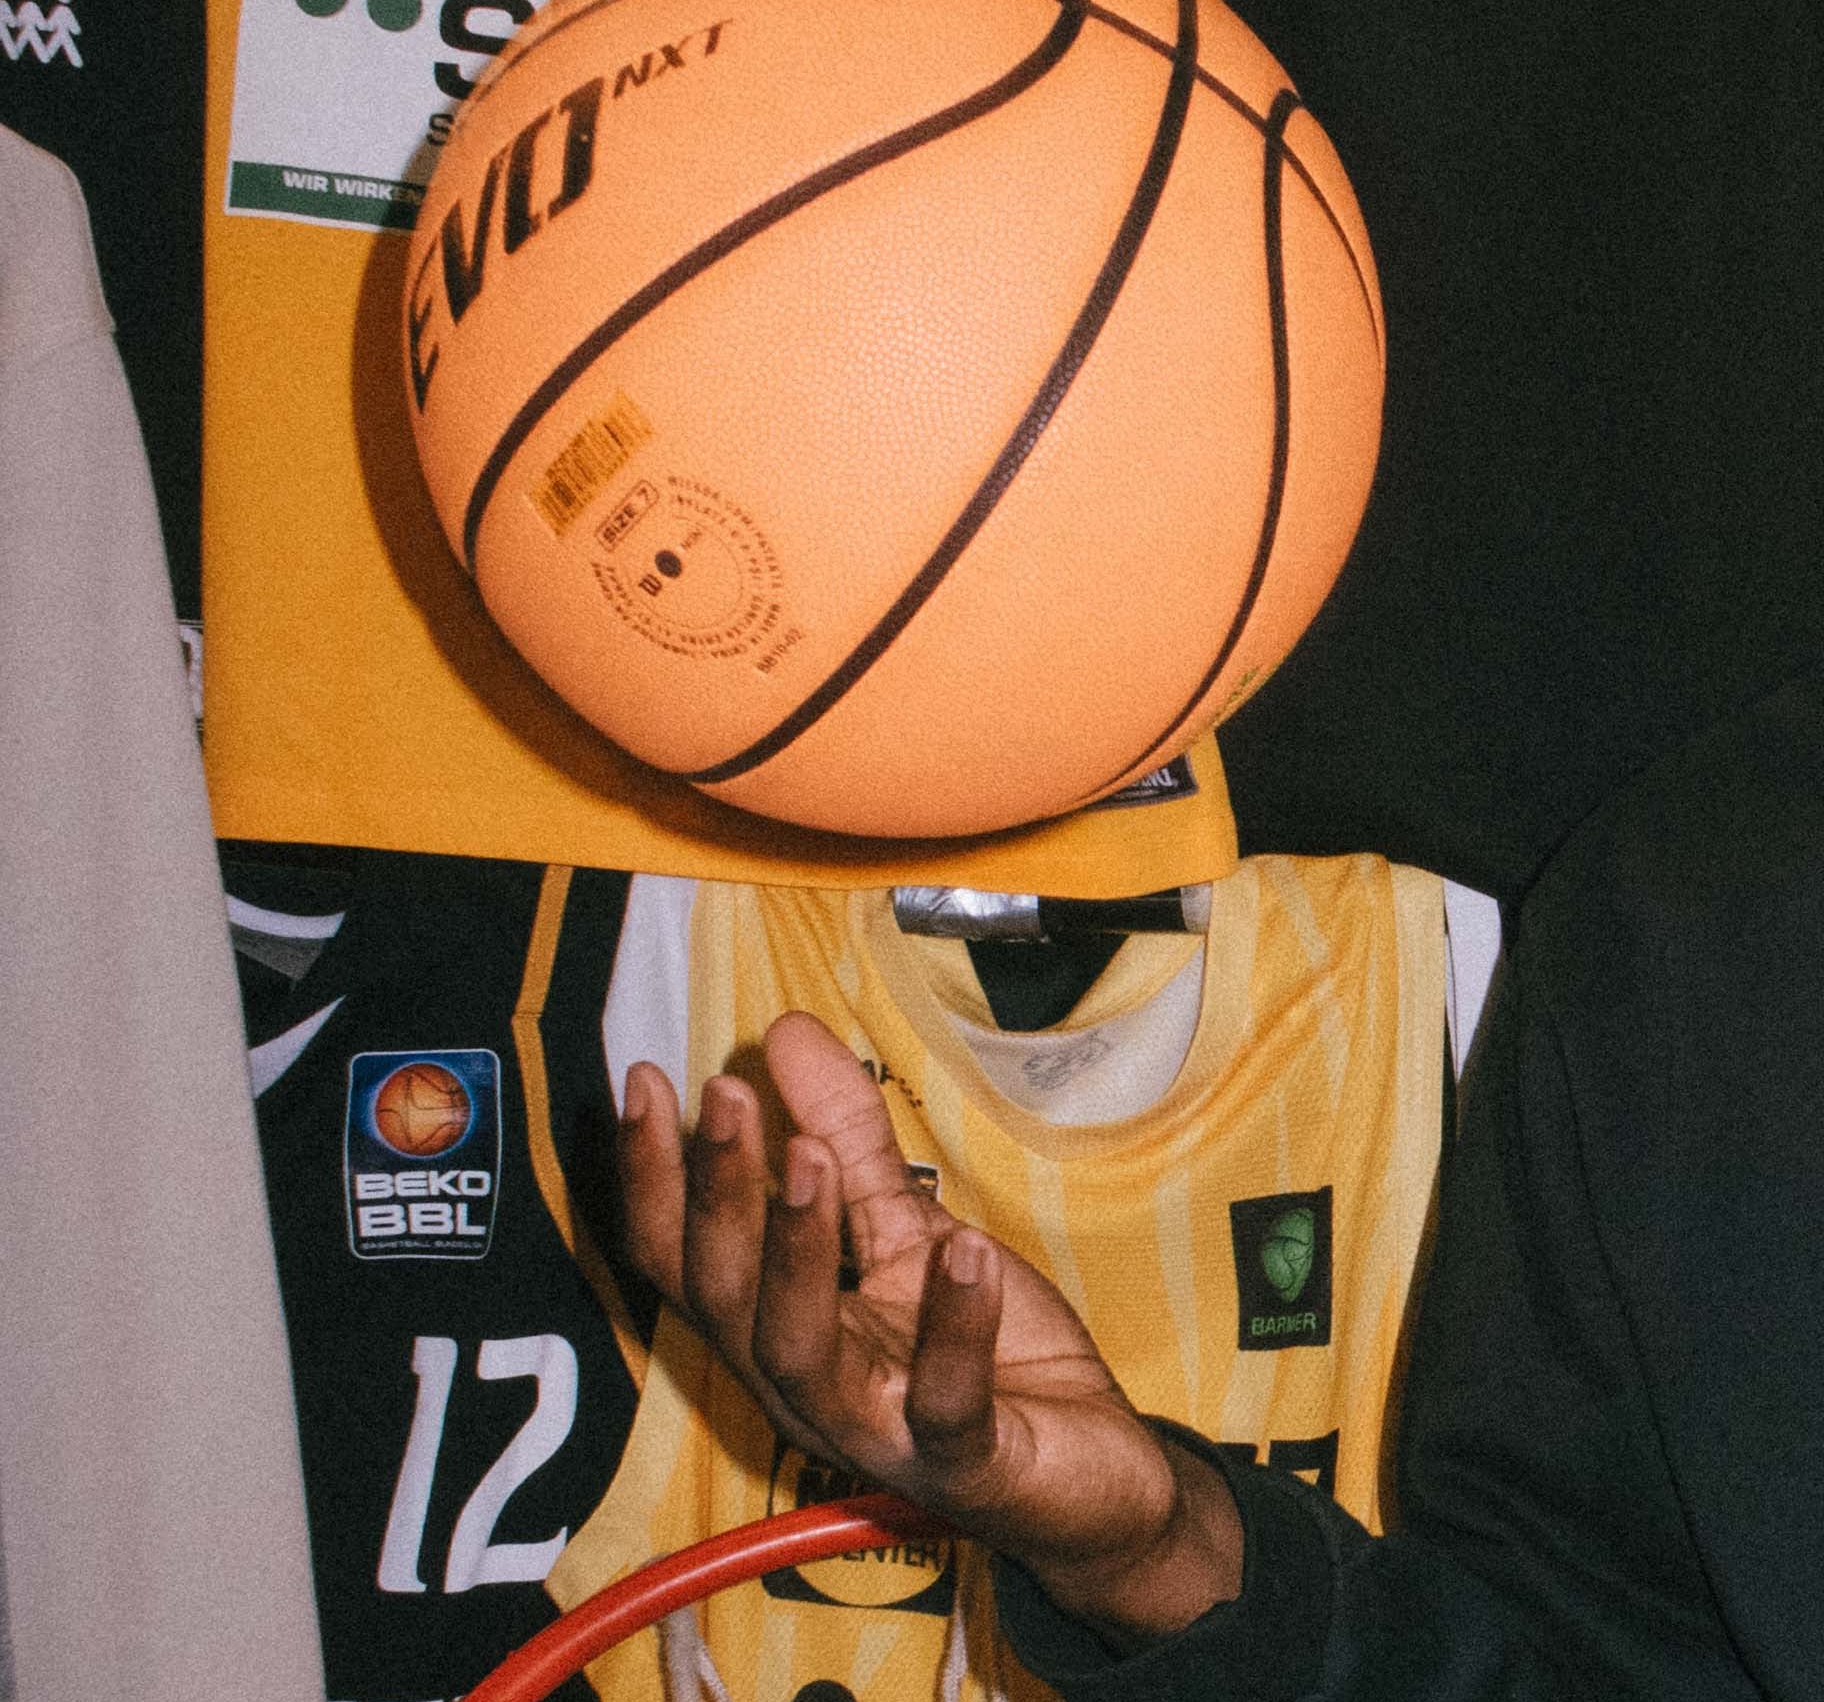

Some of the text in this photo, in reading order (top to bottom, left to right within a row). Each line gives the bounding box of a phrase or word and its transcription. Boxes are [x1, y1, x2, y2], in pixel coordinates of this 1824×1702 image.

[283, 170, 329, 195] WIR
[356, 1170, 491, 1200] BEKO
[357, 1202, 487, 1237] BBL
[377, 1333, 580, 1594] 12
